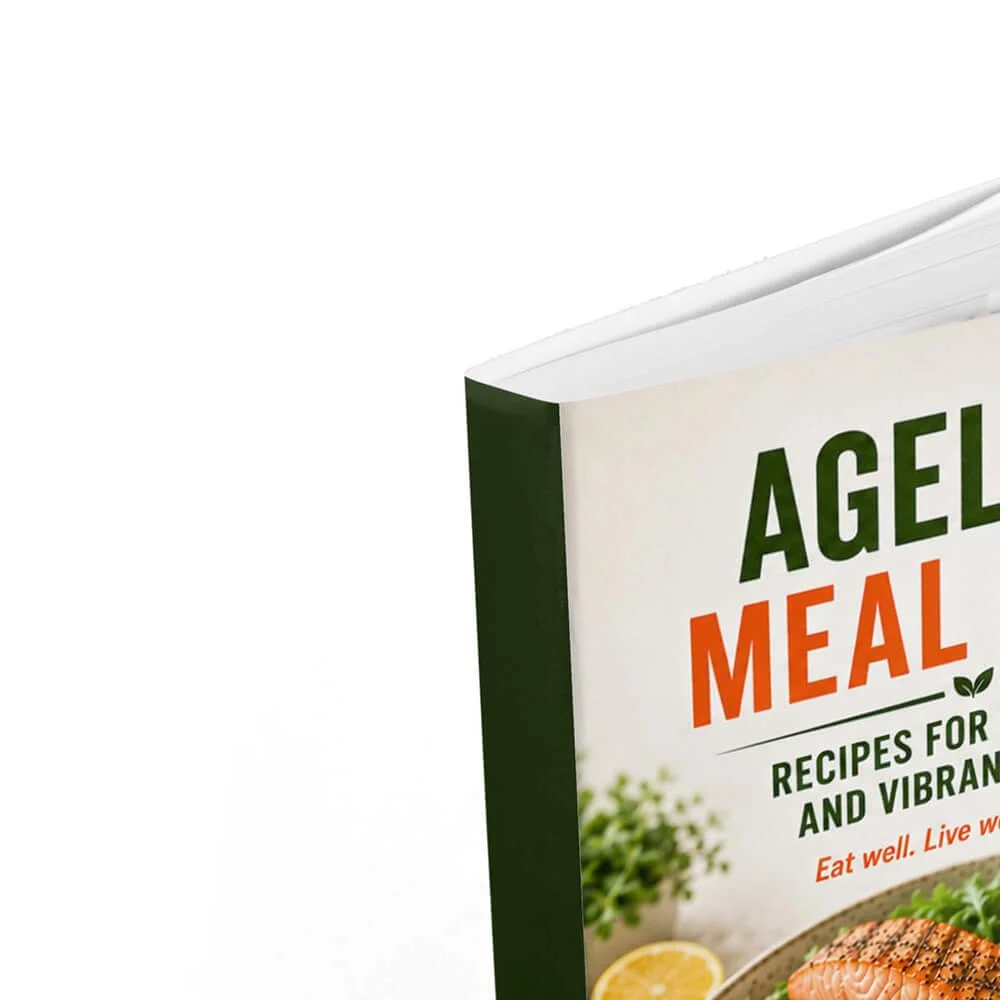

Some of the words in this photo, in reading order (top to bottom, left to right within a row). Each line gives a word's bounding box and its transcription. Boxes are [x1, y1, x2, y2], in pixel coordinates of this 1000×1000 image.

[689, 558, 968, 729] MEAL
[772, 729, 913, 799] RECIPES
[926, 709, 988, 757] FOR
[798, 789, 866, 839] AND
[815, 852, 856, 883] Eat
[862, 833, 915, 869] well.
[923, 823, 971, 853] Live
